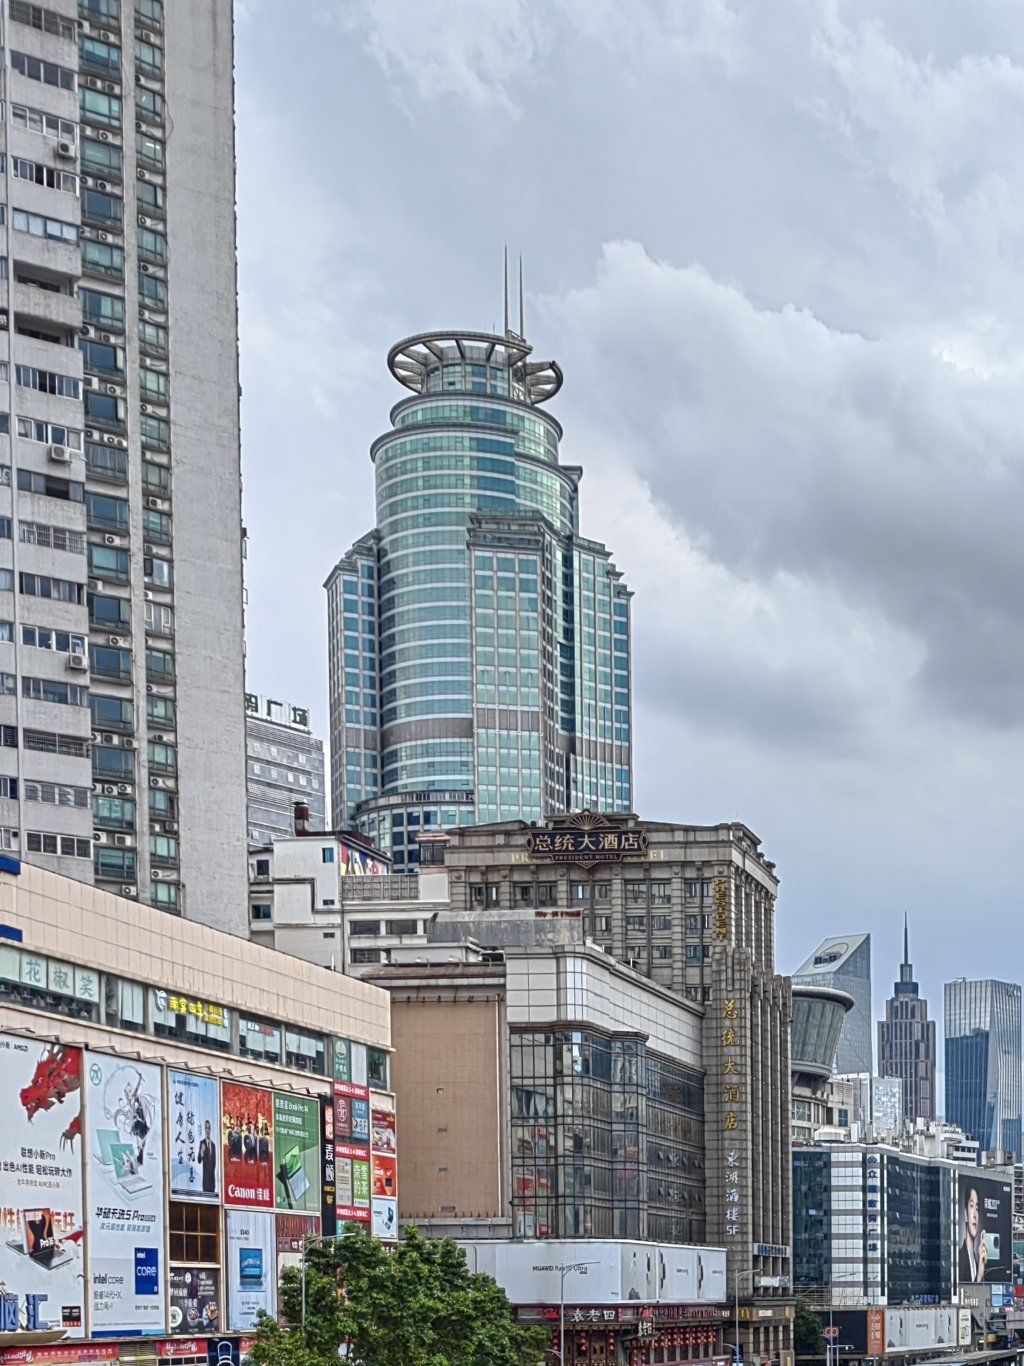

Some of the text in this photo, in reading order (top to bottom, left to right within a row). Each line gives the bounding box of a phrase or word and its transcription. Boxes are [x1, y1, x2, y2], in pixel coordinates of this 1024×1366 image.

[535, 833, 640, 852] 总统大酒店
[26, 956, 94, 998] 花椒笑
[721, 998, 740, 1131] 总统大酒店
[228, 1184, 270, 1200] Canon 佳能
[725, 1225, 740, 1237] 5F
[93, 1273, 107, 1285] intel
[572, 1308, 616, 1322] 袁老四
